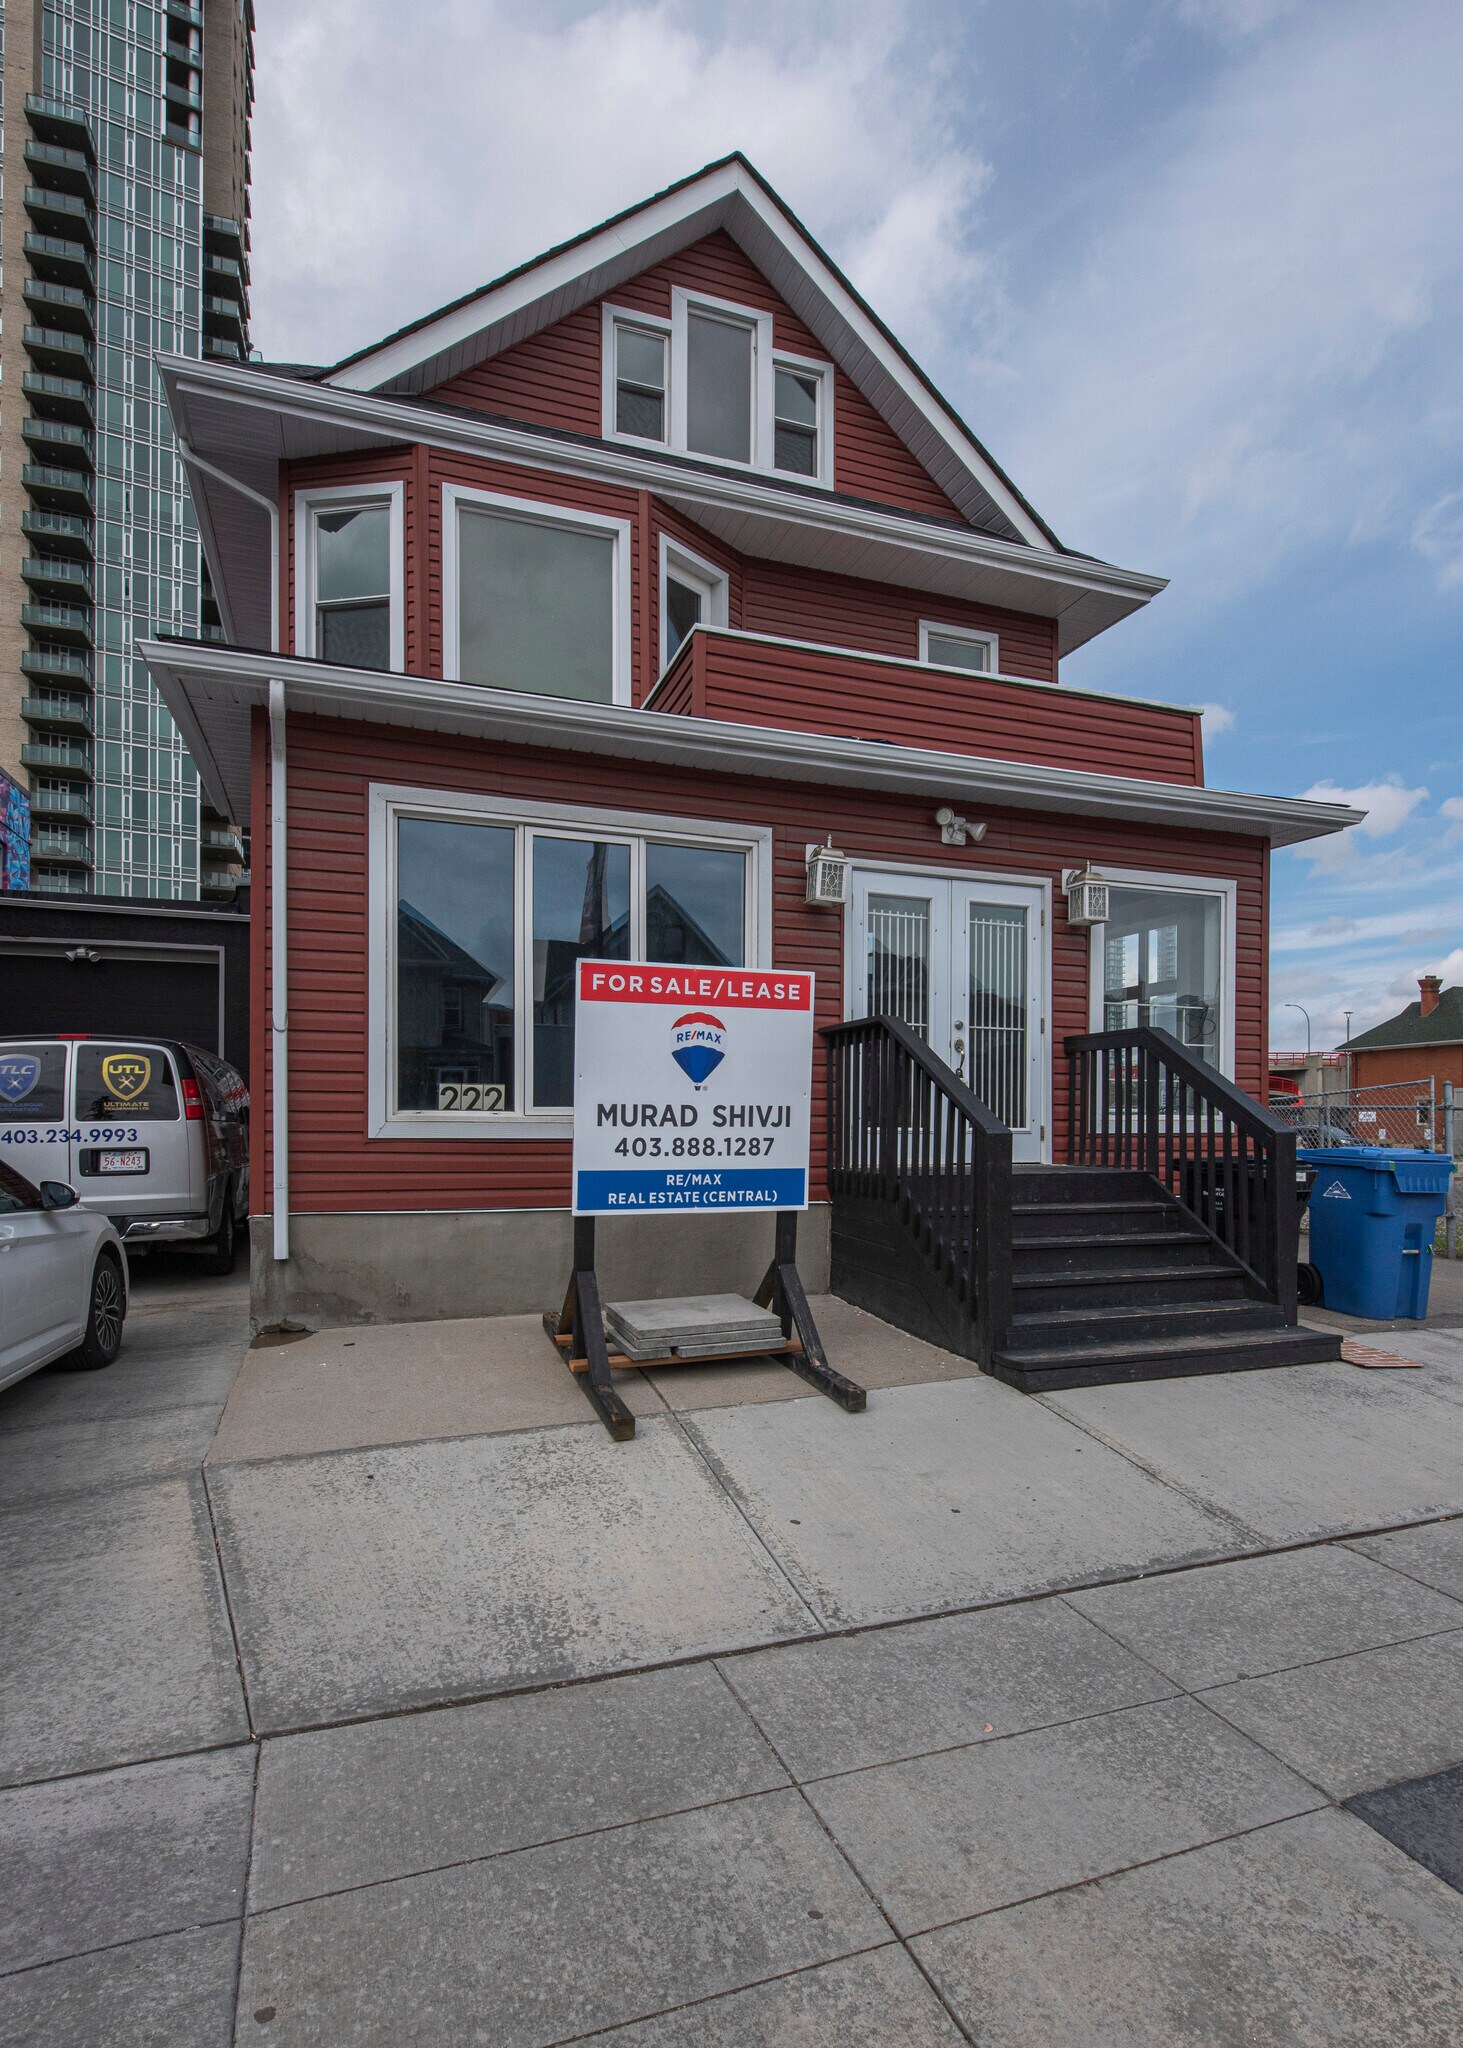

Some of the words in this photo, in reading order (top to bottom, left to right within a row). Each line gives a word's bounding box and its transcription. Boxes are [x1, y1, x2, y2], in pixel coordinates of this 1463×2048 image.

[592, 973, 644, 993] FOR
[650, 977, 801, 1001] SALE/LEASE
[676, 1030, 722, 1045] RE/MAX
[0, 1065, 35, 1074] TLC
[109, 1065, 145, 1073] UTL
[440, 1086, 504, 1111] 222
[596, 1103, 698, 1127] MURAD
[712, 1105, 791, 1128] SHIVJI
[1, 1128, 138, 1144] 403.234.9993
[614, 1137, 775, 1157] 403.888.1287
[104, 1156, 141, 1167] 56-N243
[666, 1173, 722, 1187] RE/MAX
[608, 1192, 648, 1205] REAL
[649, 1191, 700, 1204] ESTATE
[703, 1189, 778, 1204] (CENTRAL)
